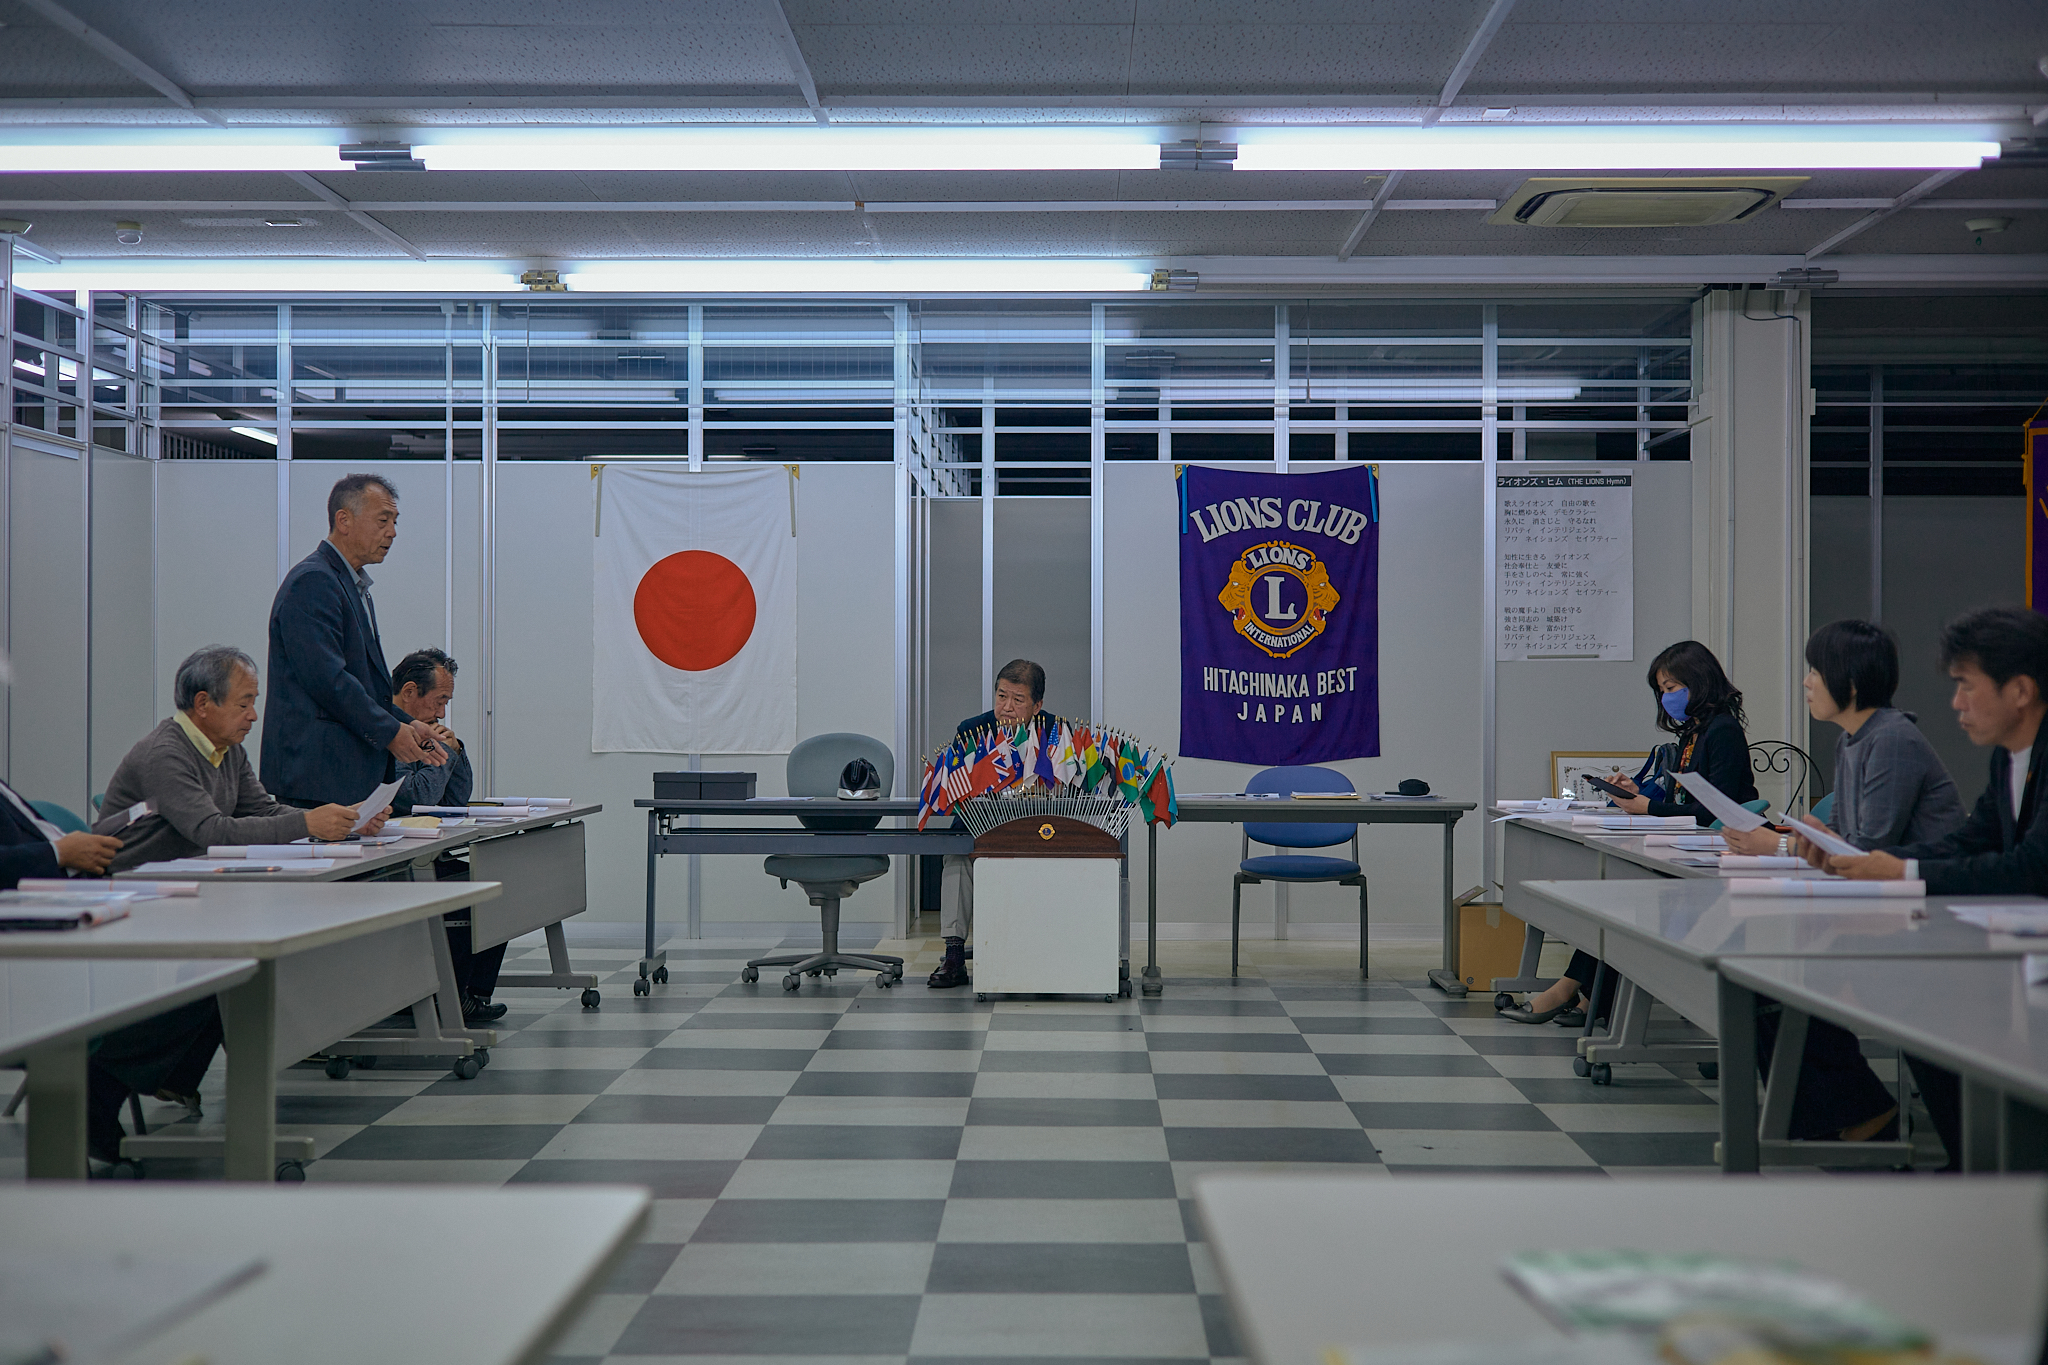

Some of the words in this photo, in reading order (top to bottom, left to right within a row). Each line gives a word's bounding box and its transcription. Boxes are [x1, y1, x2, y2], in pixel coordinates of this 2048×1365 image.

[1497, 477, 1563, 486] ライオンズ・ヒム
[1585, 477, 1605, 486] LIONS
[1190, 496, 1283, 543] LIONS
[1287, 499, 1368, 545] CLUB
[1247, 546, 1311, 570] LIONS
[1263, 576, 1298, 620] L
[1243, 621, 1316, 649] INTERNATIONAL
[1203, 666, 1310, 699] HITACHINAKA
[1317, 667, 1358, 697] BEST
[1237, 702, 1322, 724] JAPAN
